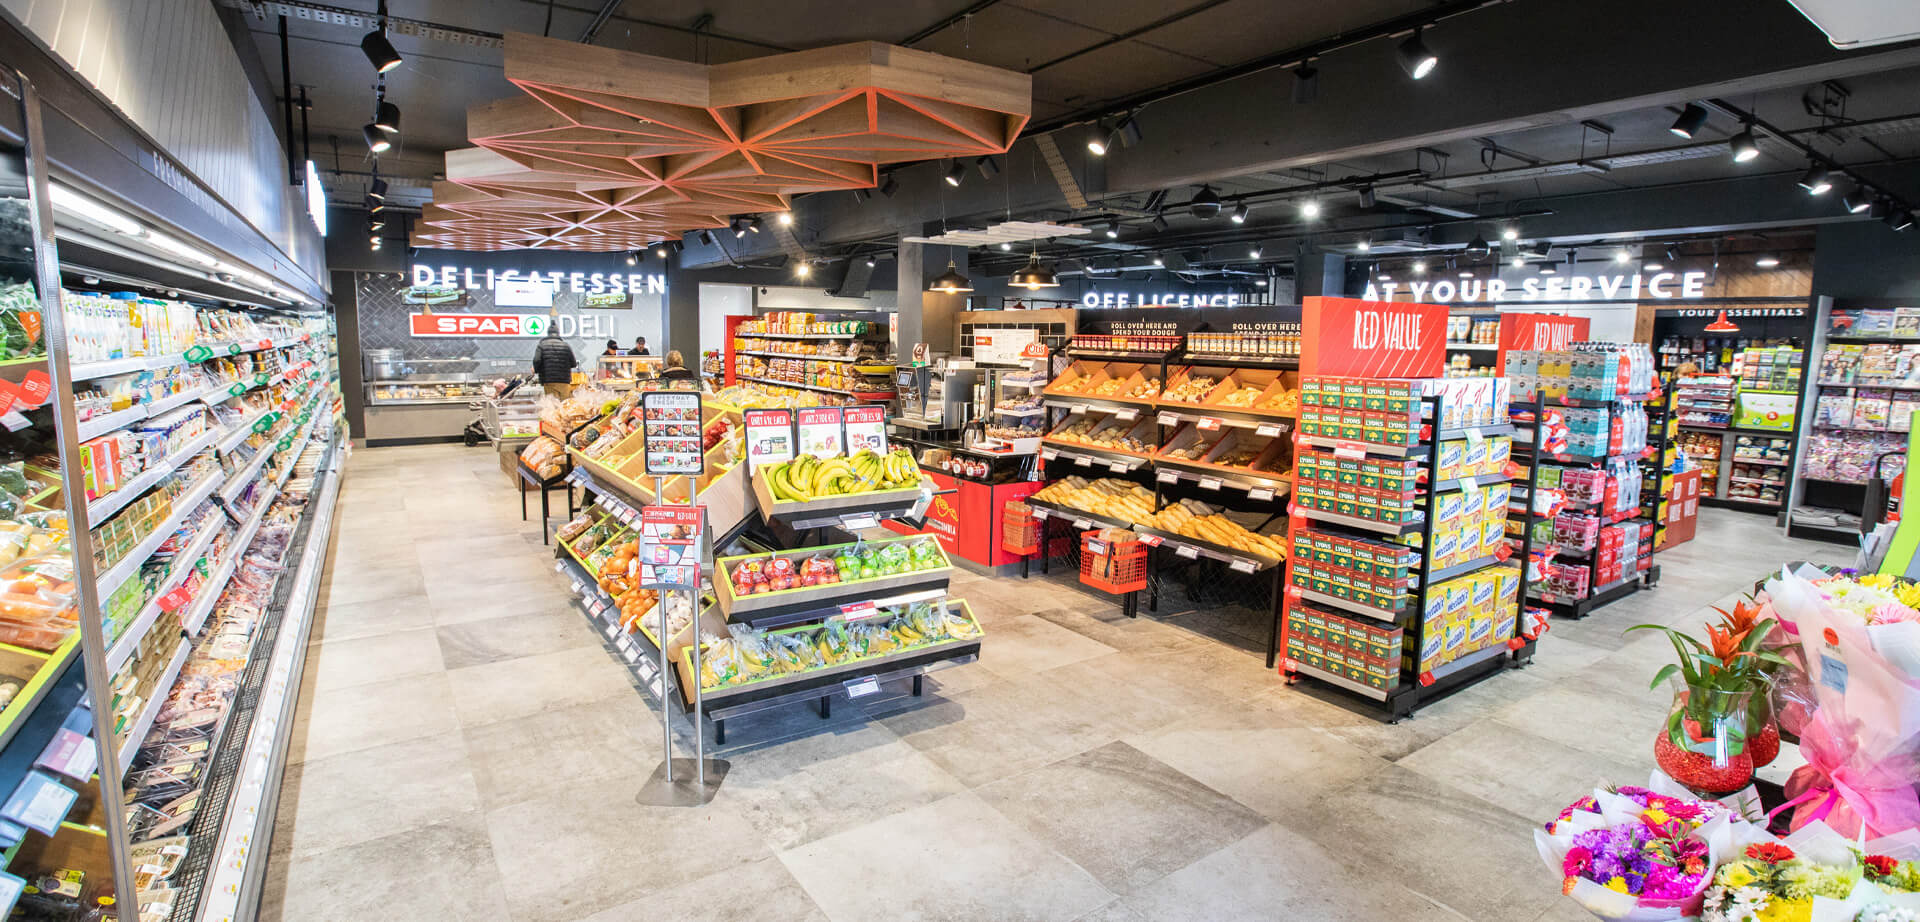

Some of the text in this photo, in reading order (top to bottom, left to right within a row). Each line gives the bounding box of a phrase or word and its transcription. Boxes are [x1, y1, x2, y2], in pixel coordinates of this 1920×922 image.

[412, 264, 665, 294] DELICATESSEN
[1362, 271, 1706, 302] AT YOUR SERVICE
[1083, 292, 1240, 308] OFF LICENCE
[1678, 309, 1714, 317] YOUR
[437, 314, 615, 337] SPAR DELI
[1353, 310, 1422, 351] RED VALUE
[1533, 322, 1550, 351] RED
[1367, 387, 1385, 395] LYONS
[1366, 419, 1383, 427] LYONS
[1388, 421, 1407, 429] LYONS
[1341, 462, 1357, 470] LYONS
[1362, 465, 1379, 473] LYONS
[1338, 492, 1355, 500] LYONS
[1382, 499, 1400, 507] LYONS
[1295, 536, 1311, 544] LYONS
[1315, 541, 1331, 549] LYONS
[1356, 550, 1372, 559] LYONS
[1377, 555, 1395, 564] LYONS
[1294, 565, 1309, 573] LYONS
[1314, 570, 1330, 579] LYONS
[1333, 575, 1350, 584] LYONS
[1354, 581, 1371, 589] LYONS
[1376, 586, 1393, 595] LYONS
[1290, 611, 1306, 619] LYONS
[1309, 616, 1325, 625] LYONS
[1328, 622, 1345, 631] LYONS
[1350, 629, 1366, 638] LYONS
[1289, 639, 1304, 647] LYONS
[1371, 634, 1388, 644] LYONS
[1307, 645, 1323, 654] LYONS
[1327, 651, 1344, 660] LYONS
[1348, 658, 1364, 668] LYONS
[1369, 665, 1386, 675] LYONS
